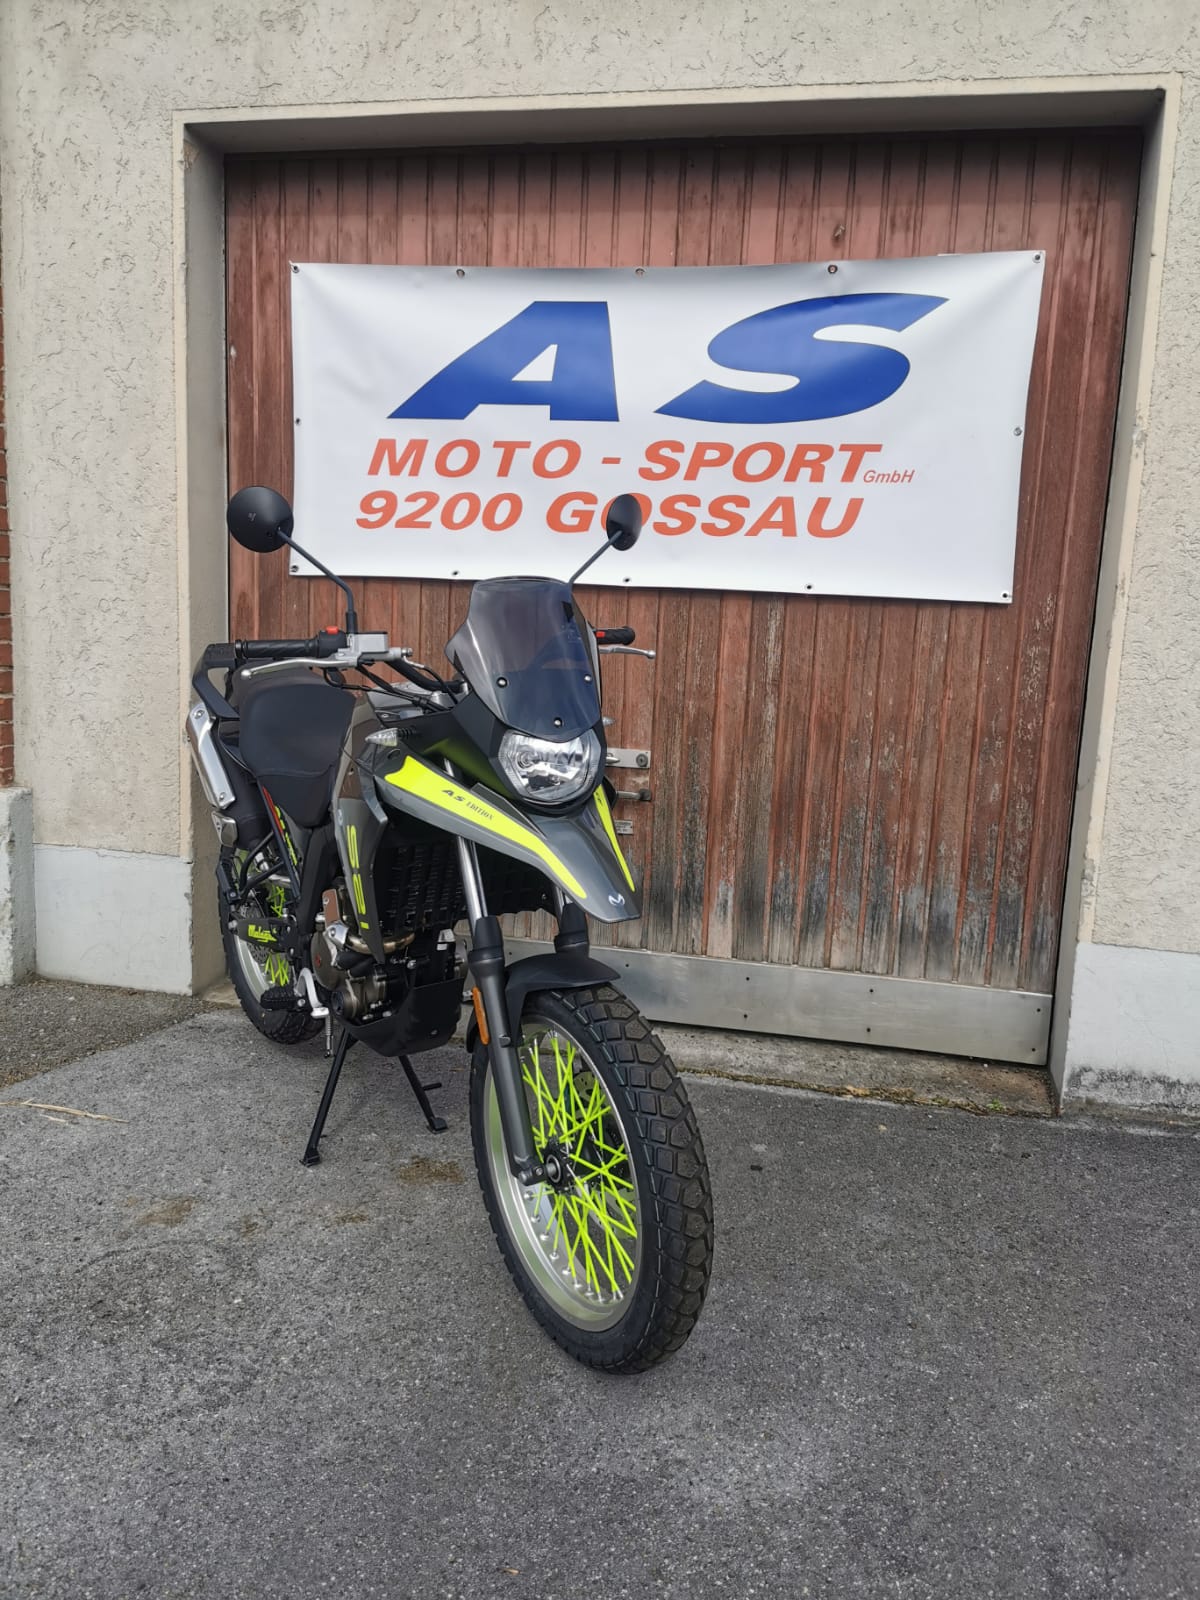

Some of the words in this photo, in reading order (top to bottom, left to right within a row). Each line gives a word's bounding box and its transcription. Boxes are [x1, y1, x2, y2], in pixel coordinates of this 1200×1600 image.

[367, 438, 581, 479] MOTO
[638, 440, 883, 483] SPORT
[863, 469, 915, 483] GmbH
[355, 490, 523, 532] 9200
